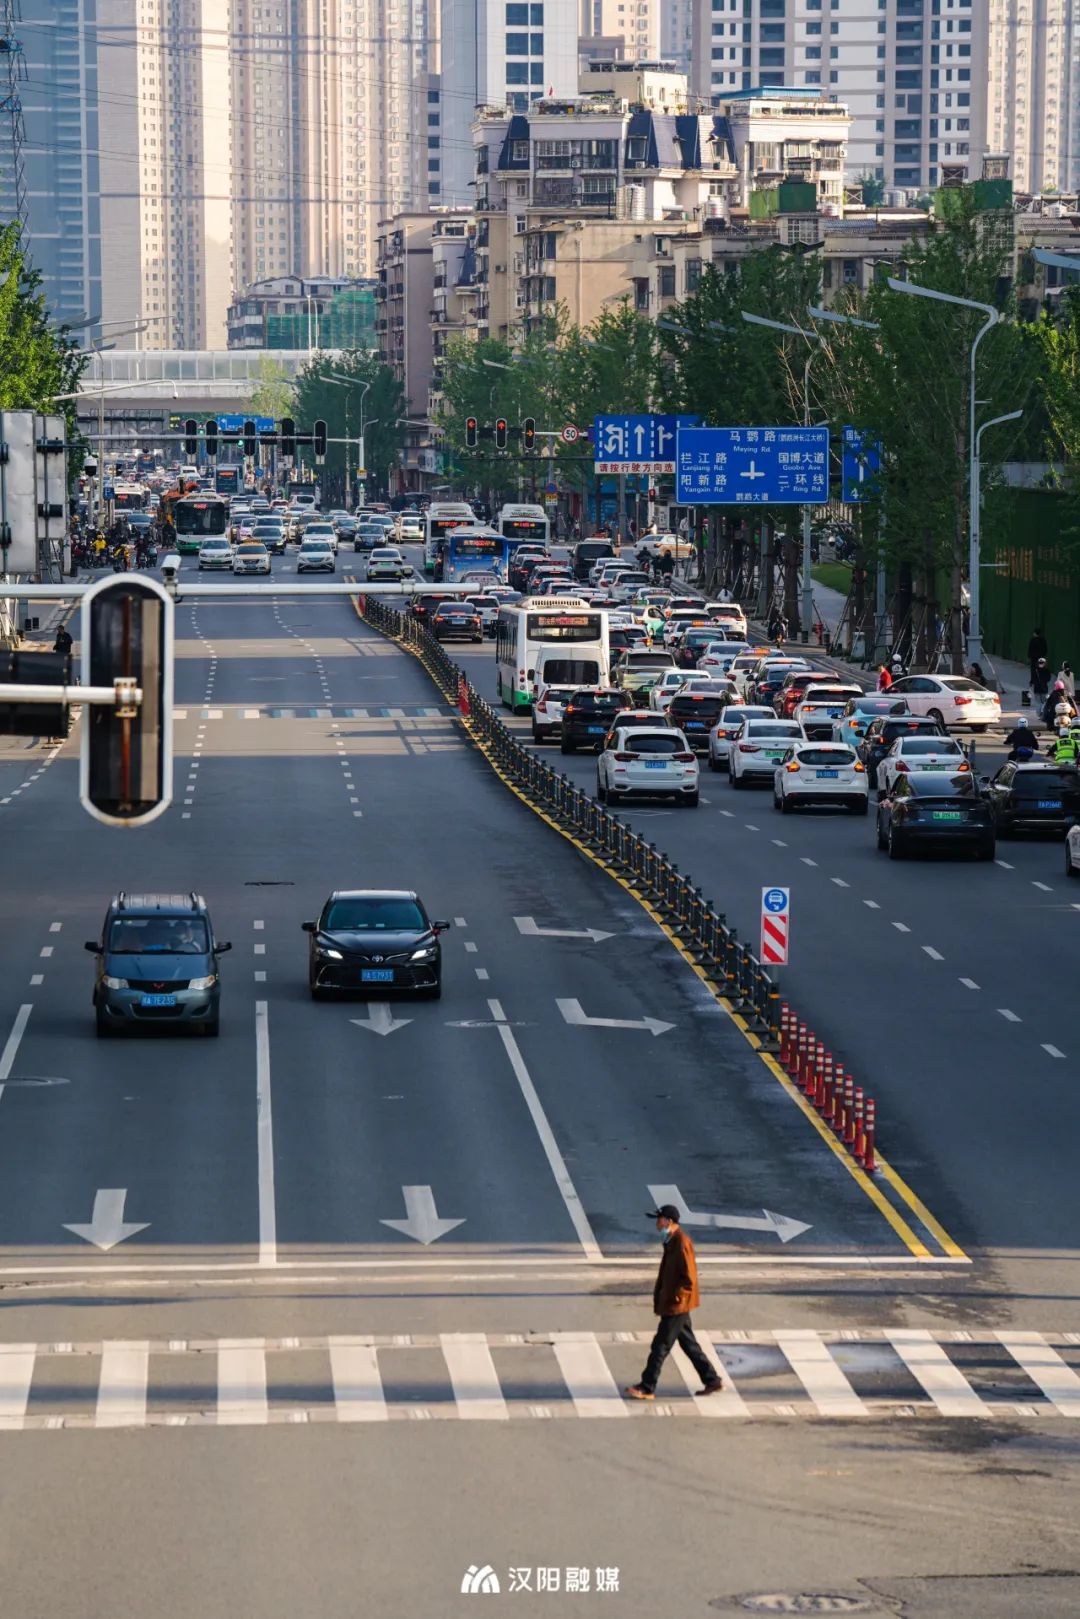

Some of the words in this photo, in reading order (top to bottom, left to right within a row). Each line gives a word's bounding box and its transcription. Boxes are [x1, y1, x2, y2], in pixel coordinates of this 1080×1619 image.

[566, 429, 576, 439] 50
[730, 430, 776, 442] 马鹦路
[680, 452, 728, 464] 拦江路
[778, 452, 825, 464] 国博大道
[682, 464, 711, 472] Lanjiang
[680, 474, 728, 486] 阳新路
[778, 474, 825, 485] 二环线
